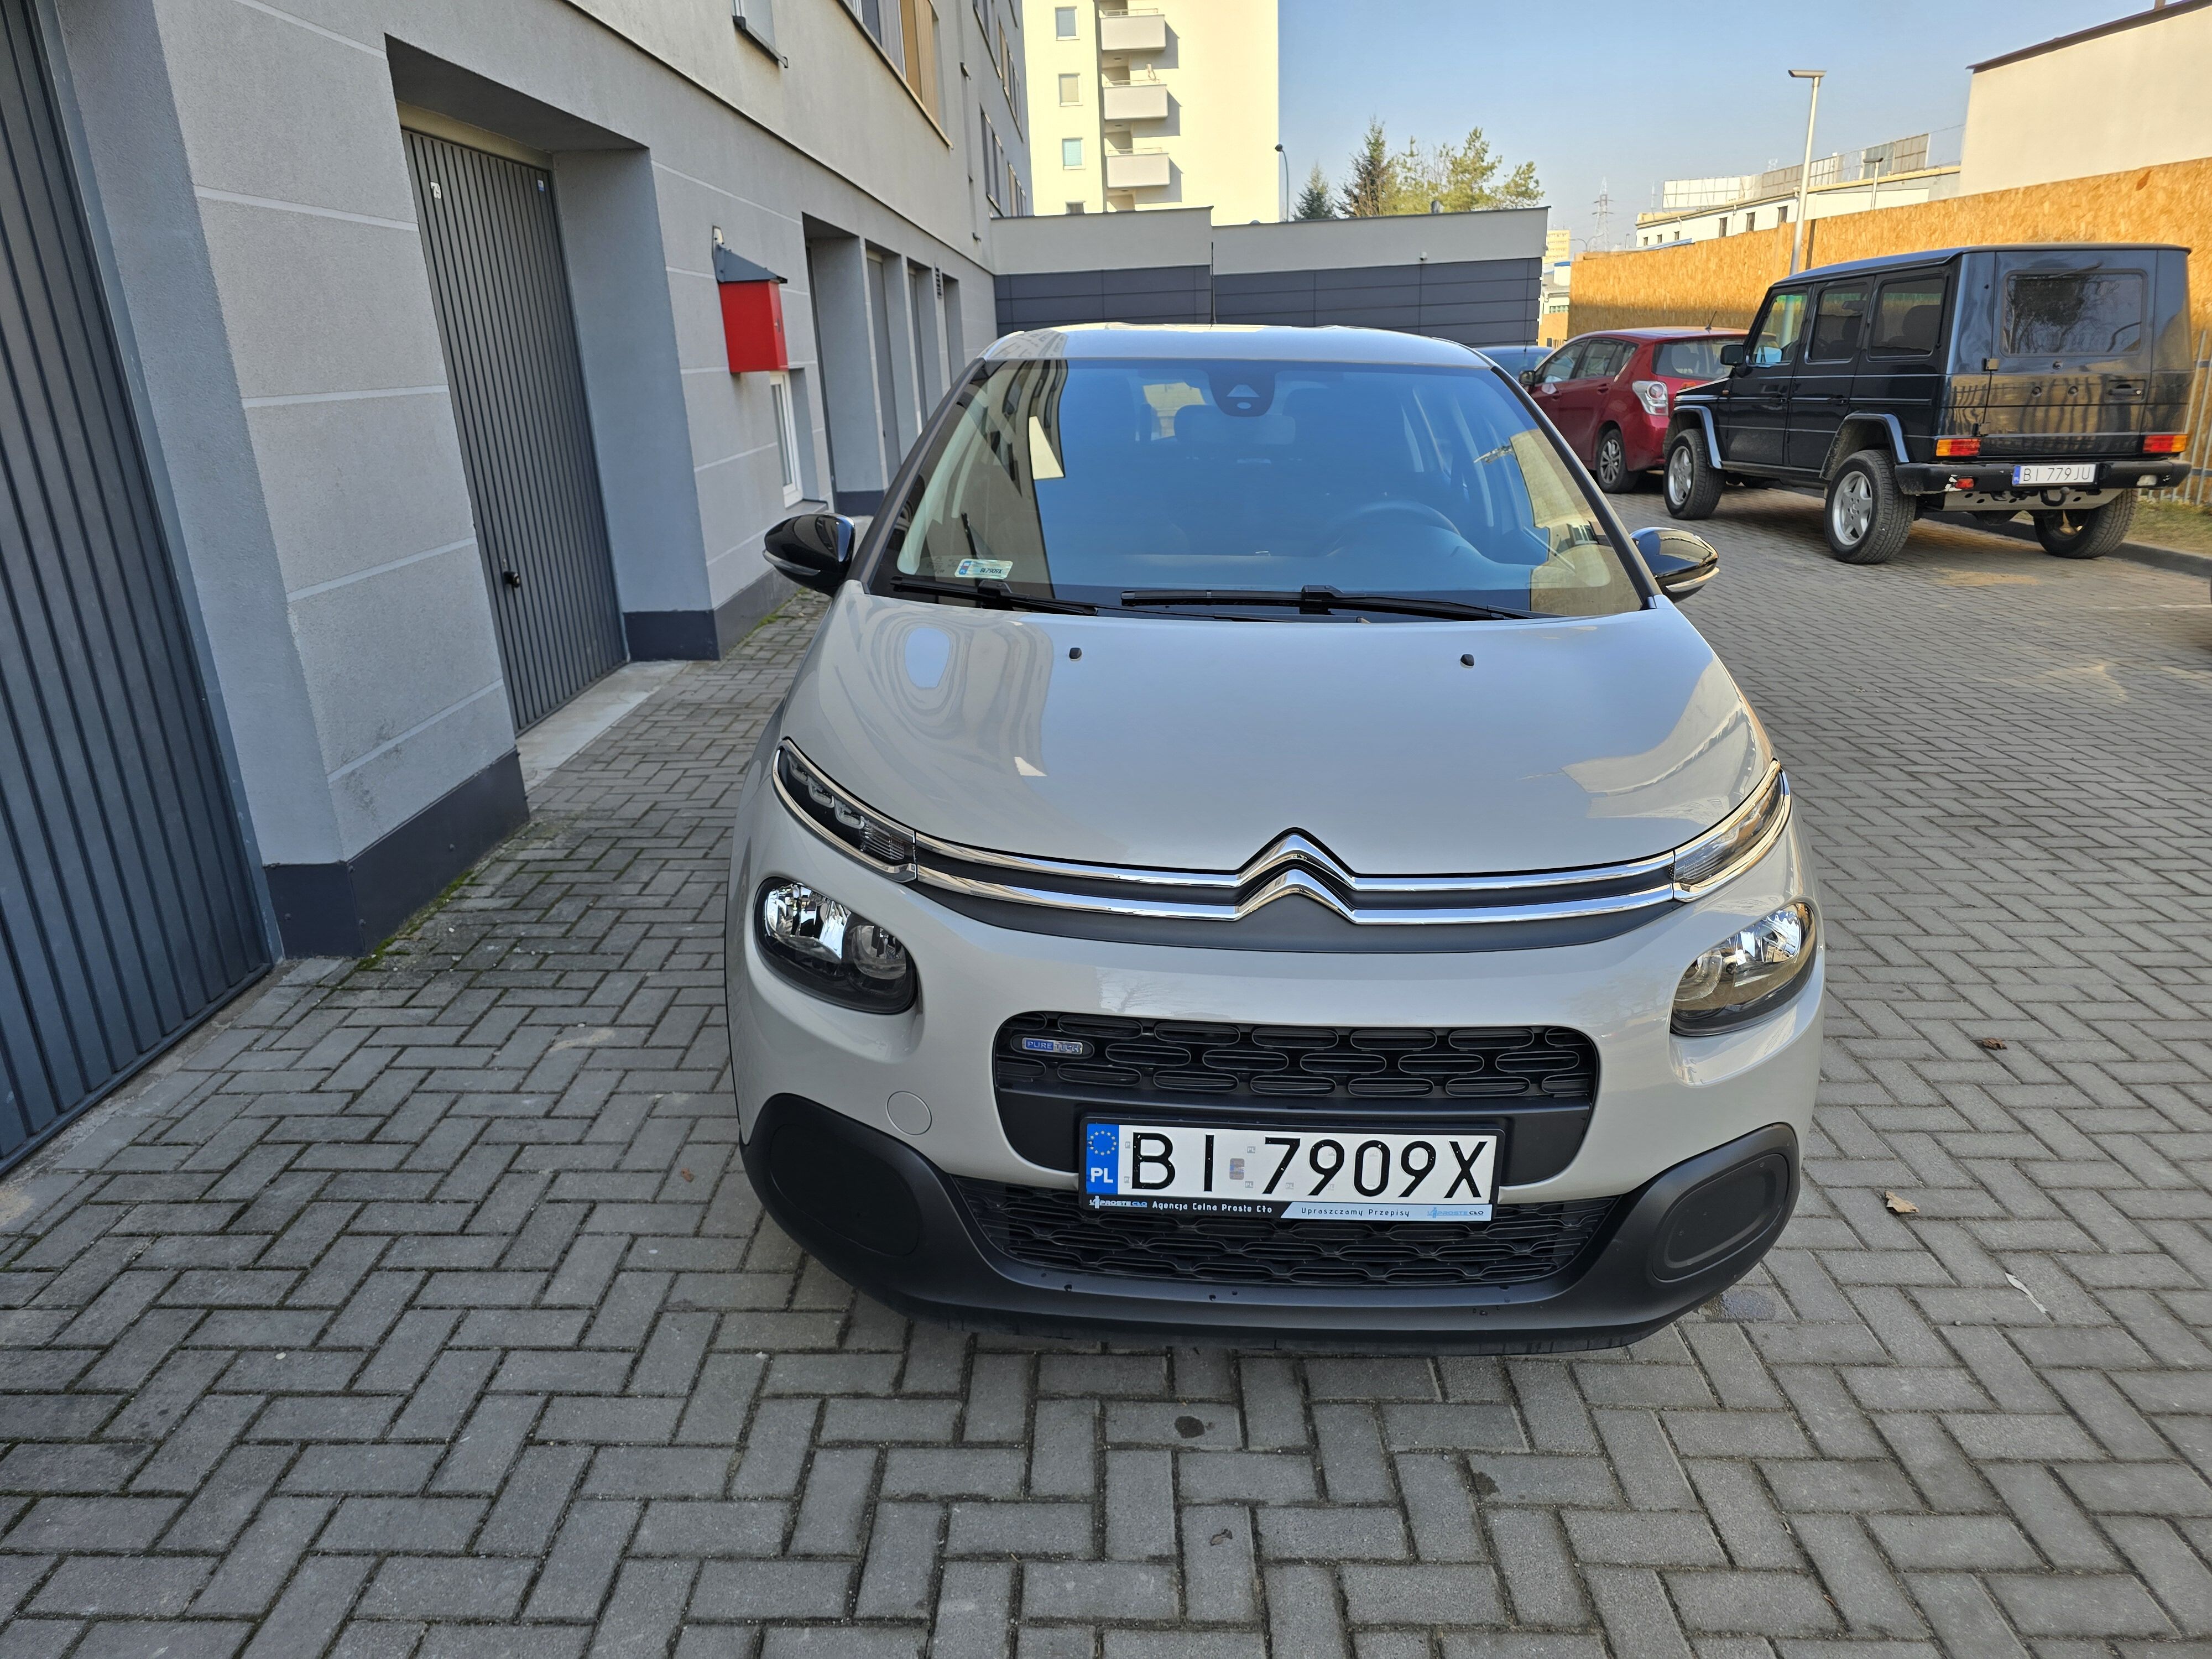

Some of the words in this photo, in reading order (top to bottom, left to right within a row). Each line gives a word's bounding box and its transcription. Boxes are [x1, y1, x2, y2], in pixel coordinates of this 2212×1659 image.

[430, 181, 441, 199] 79
[2023, 468, 2039, 481] BI
[2047, 467, 2090, 481] 779JU
[1027, 1041, 1052, 1050] PURE
[1262, 1136, 1488, 1198] 7909X
[1090, 1167, 1114, 1183] PL
[1152, 1201, 1188, 1211] Agencja
[1192, 1202, 1217, 1212] Celna
[1222, 1203, 1252, 1213] Proste
[1301, 1207, 1363, 1217] Upraszczamy
[1368, 1208, 1410, 1217] Przepisy
